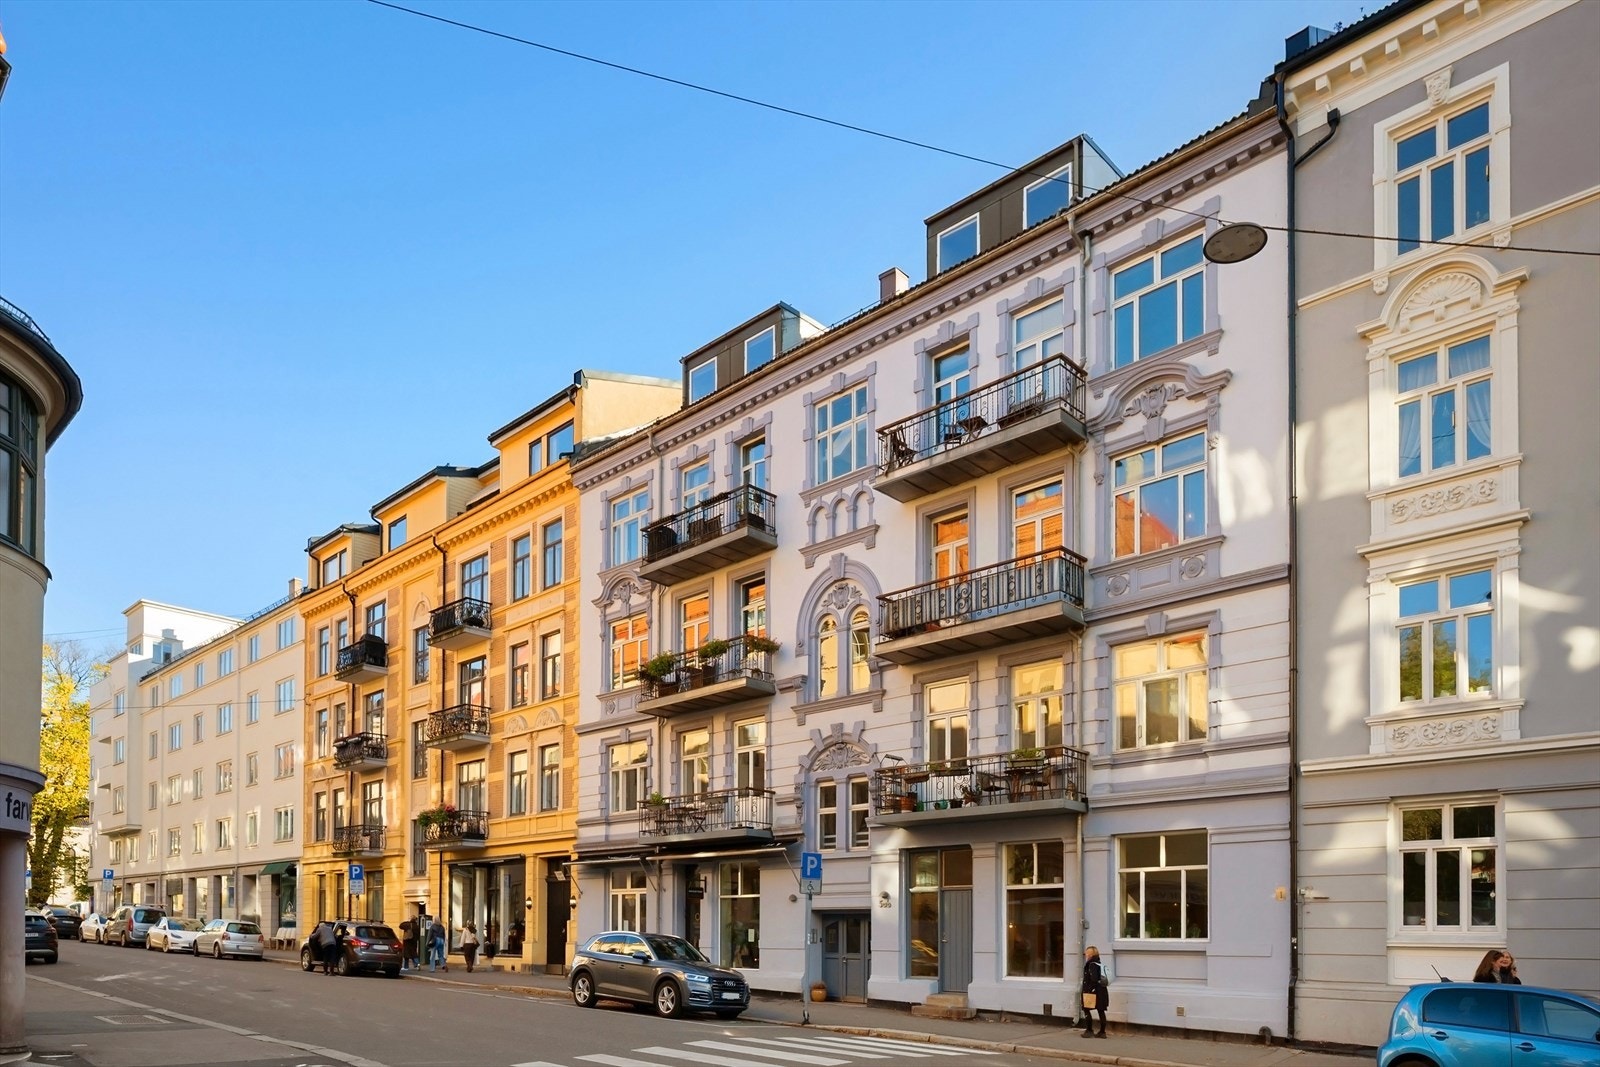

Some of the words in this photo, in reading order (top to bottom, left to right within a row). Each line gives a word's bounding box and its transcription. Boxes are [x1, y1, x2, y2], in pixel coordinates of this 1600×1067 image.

[352, 866, 360, 878] P
[807, 856, 818, 876] P
[105, 870, 112, 878] P
